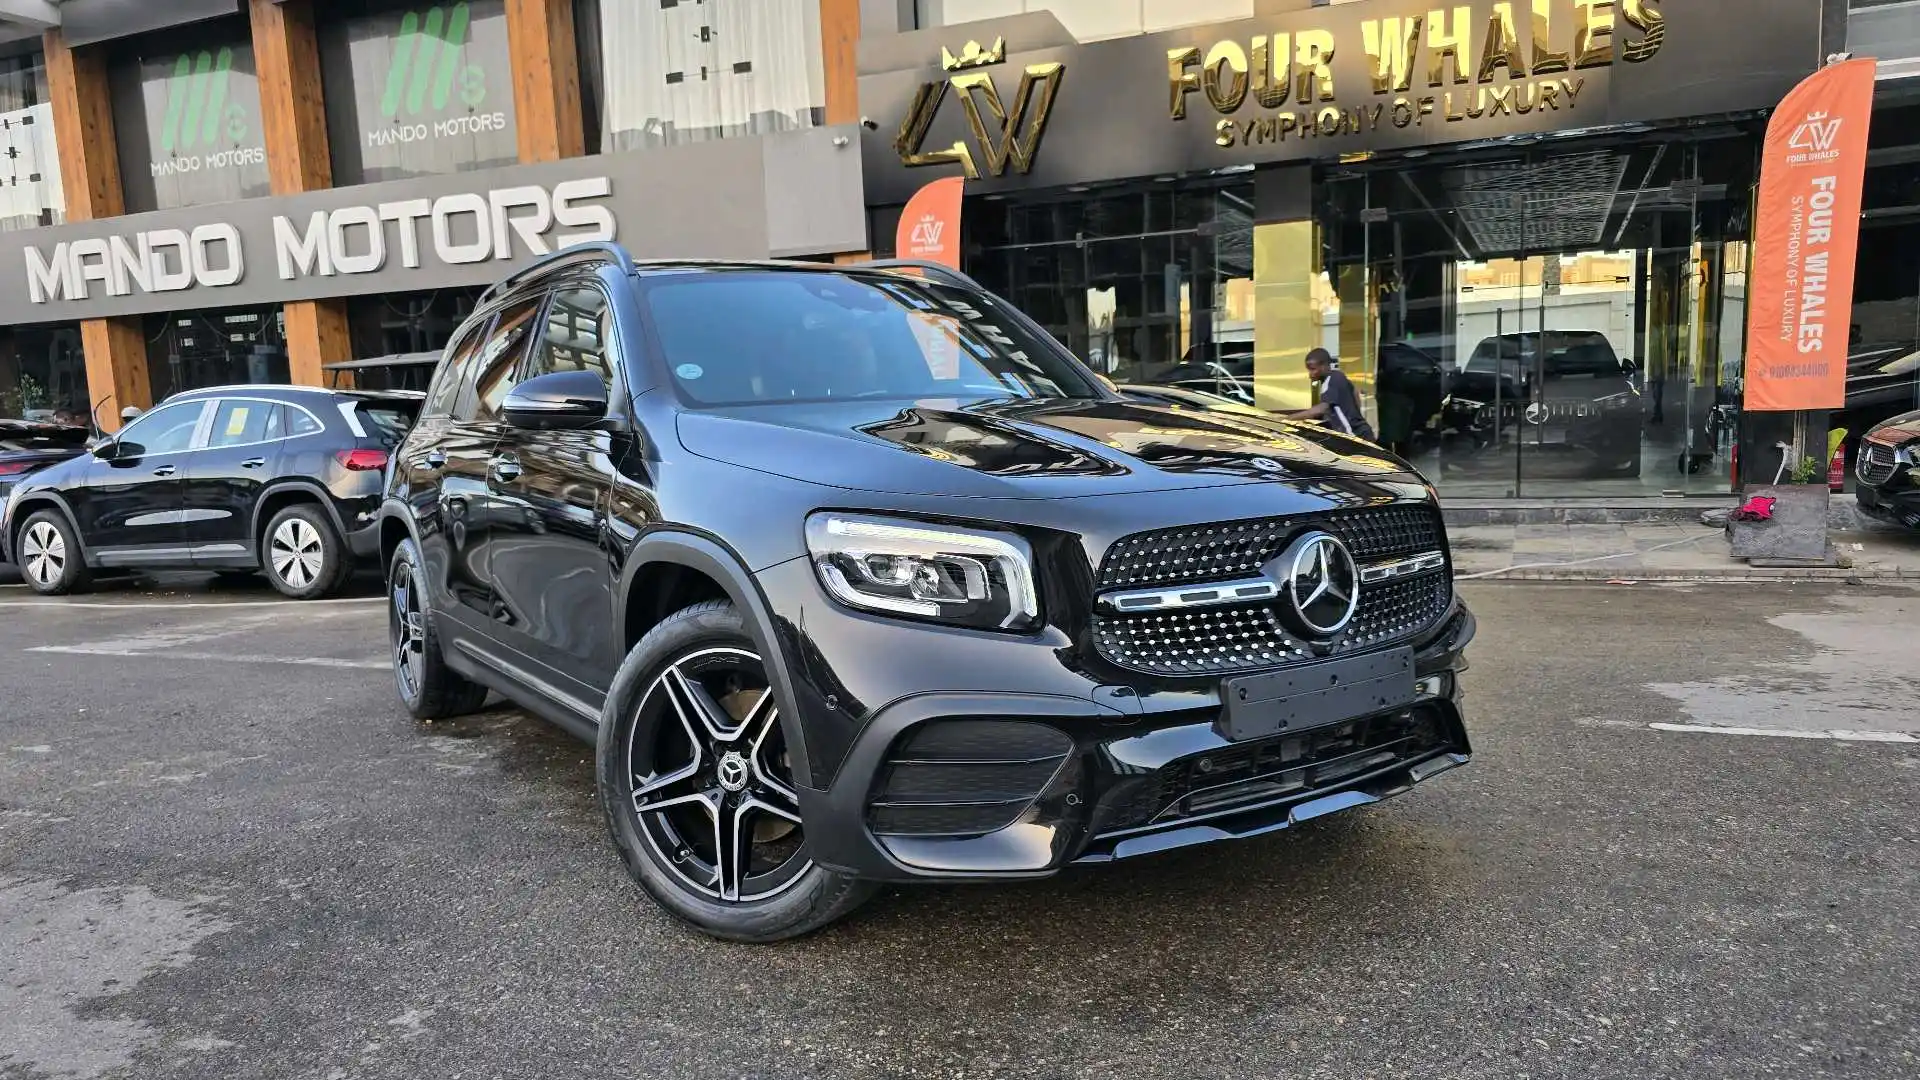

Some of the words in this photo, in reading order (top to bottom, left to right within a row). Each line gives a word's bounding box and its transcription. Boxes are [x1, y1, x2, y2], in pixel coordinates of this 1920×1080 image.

[1167, 29, 1336, 121] FOUR
[1361, 0, 1665, 95] WHALES
[368, 124, 428, 147] MANDO
[434, 112, 506, 138] MOTORS
[1215, 102, 1384, 149] SYMPHONY
[1391, 97, 1434, 129] OF
[1444, 77, 1585, 122] LUXURY
[151, 156, 202, 177] MANDO
[205, 147, 265, 169] MOTORS
[24, 222, 245, 304] MANDO
[273, 176, 617, 280] MOTORS
[1787, 195, 1804, 267] SYMPHONY
[1807, 175, 1837, 245] FOUR
[1785, 269, 1798, 287] OF
[1797, 251, 1828, 354] WHALES
[1780, 289, 1797, 341] LUXURY
